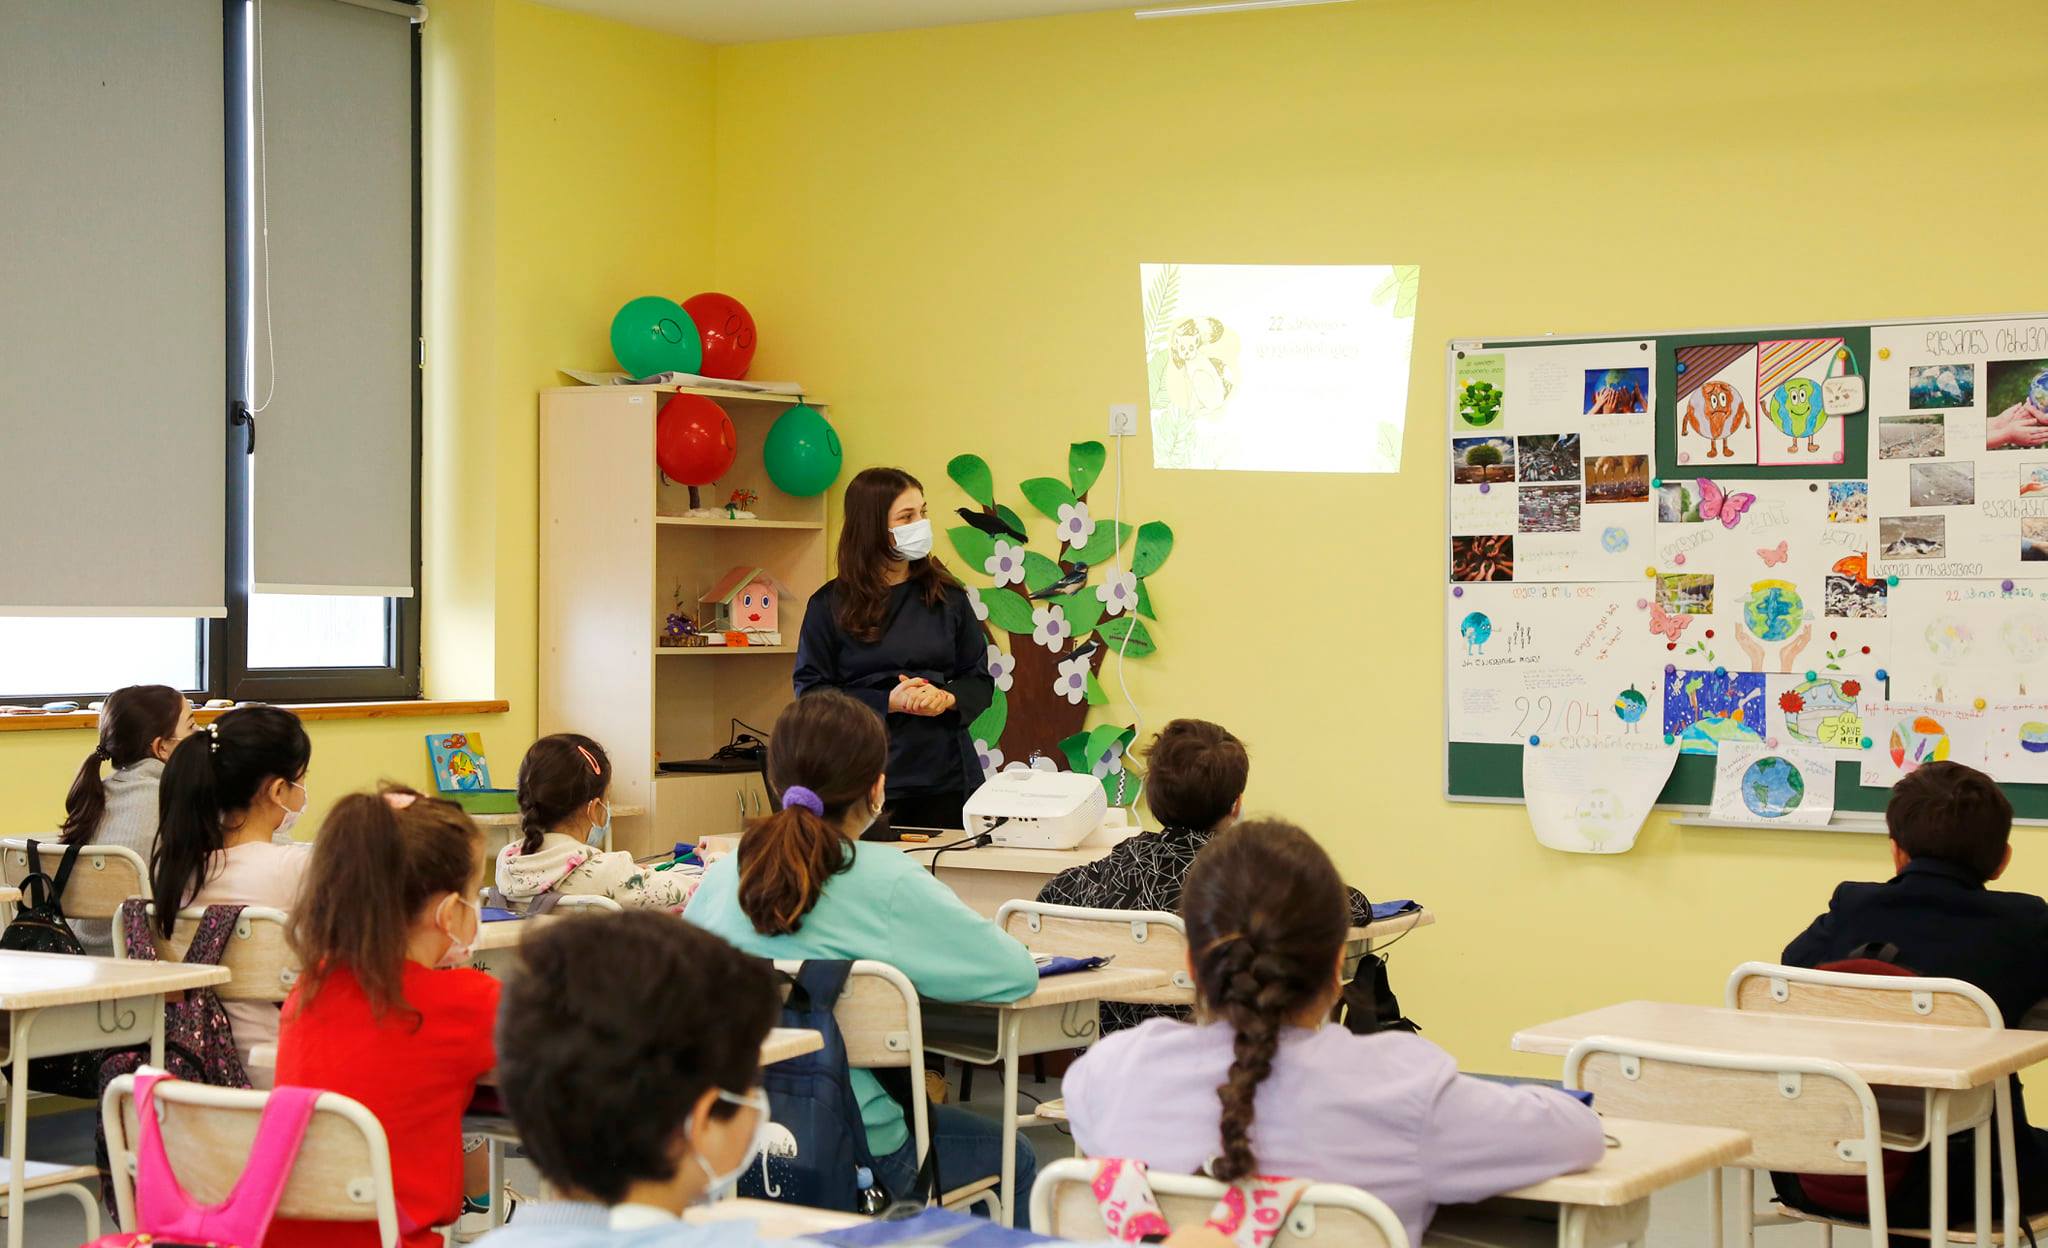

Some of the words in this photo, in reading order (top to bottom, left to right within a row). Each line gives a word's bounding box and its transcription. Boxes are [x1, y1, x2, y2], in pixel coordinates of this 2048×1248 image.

[1268, 315, 1284, 331] 22
[1945, 589, 1961, 602] 22
[1840, 726, 1861, 736] SAVE
[1840, 736, 1859, 746] ME!
[1864, 772, 1879, 784] 22
